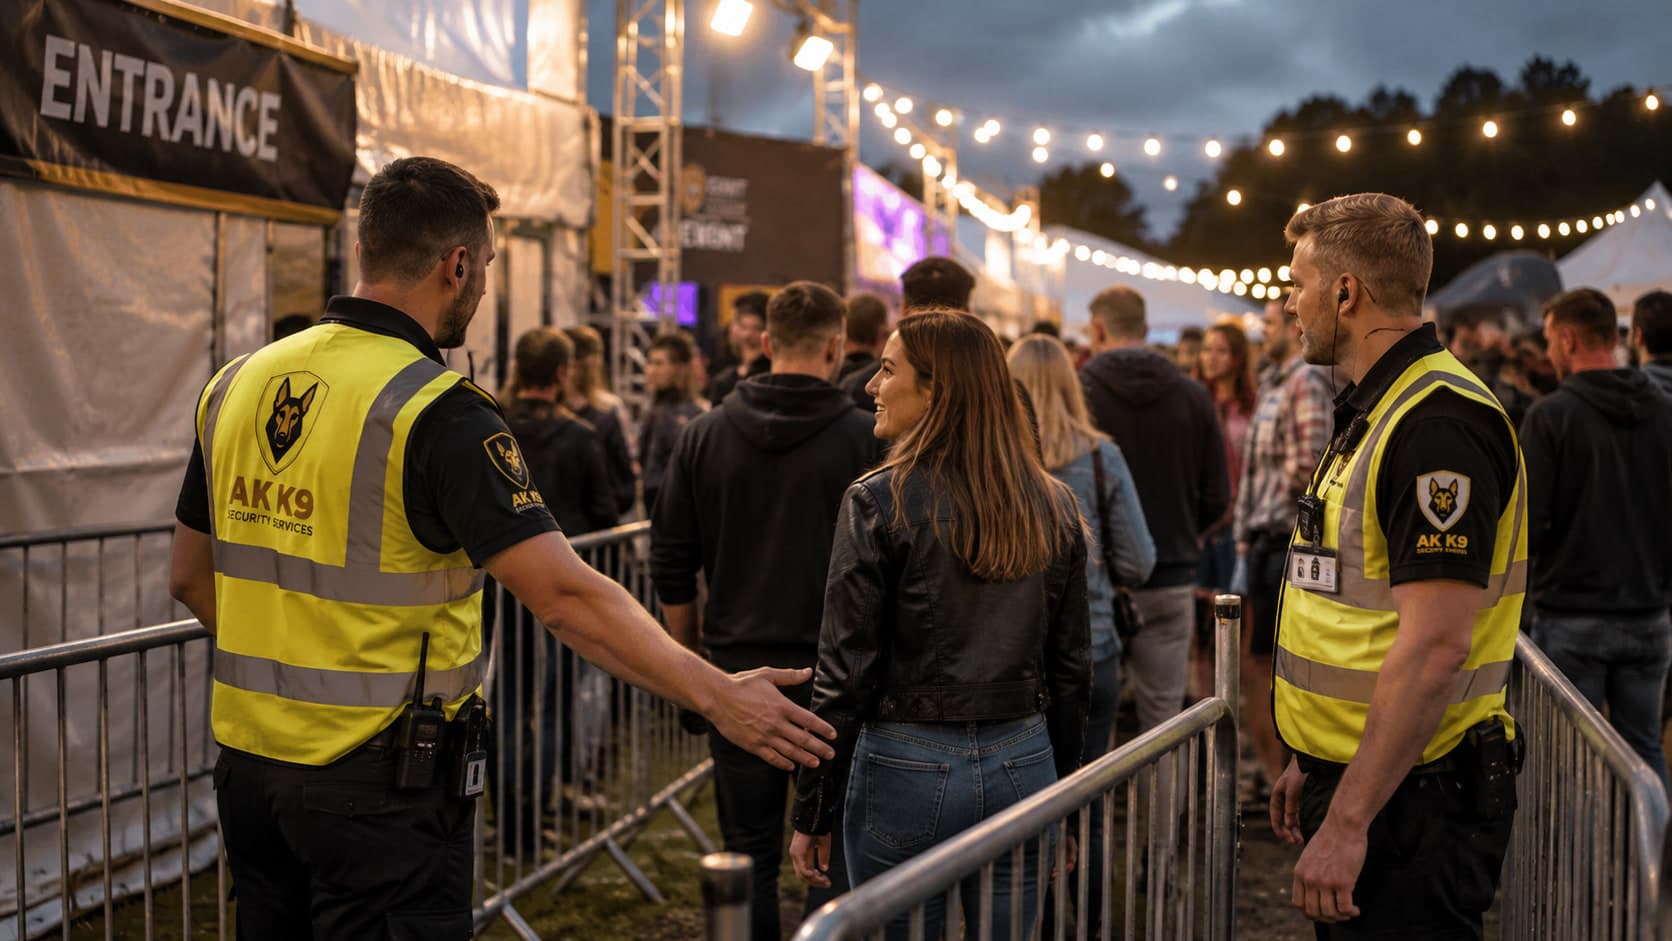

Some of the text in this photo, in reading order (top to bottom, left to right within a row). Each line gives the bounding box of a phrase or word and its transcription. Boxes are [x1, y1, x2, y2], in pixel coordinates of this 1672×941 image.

[40, 34, 281, 162] ENTRANCE
[229, 475, 314, 521] AK K9
[512, 491, 532, 508] AK
[227, 509, 313, 537] SECURITY SERVICES
[1416, 533, 1469, 549] AK K9
